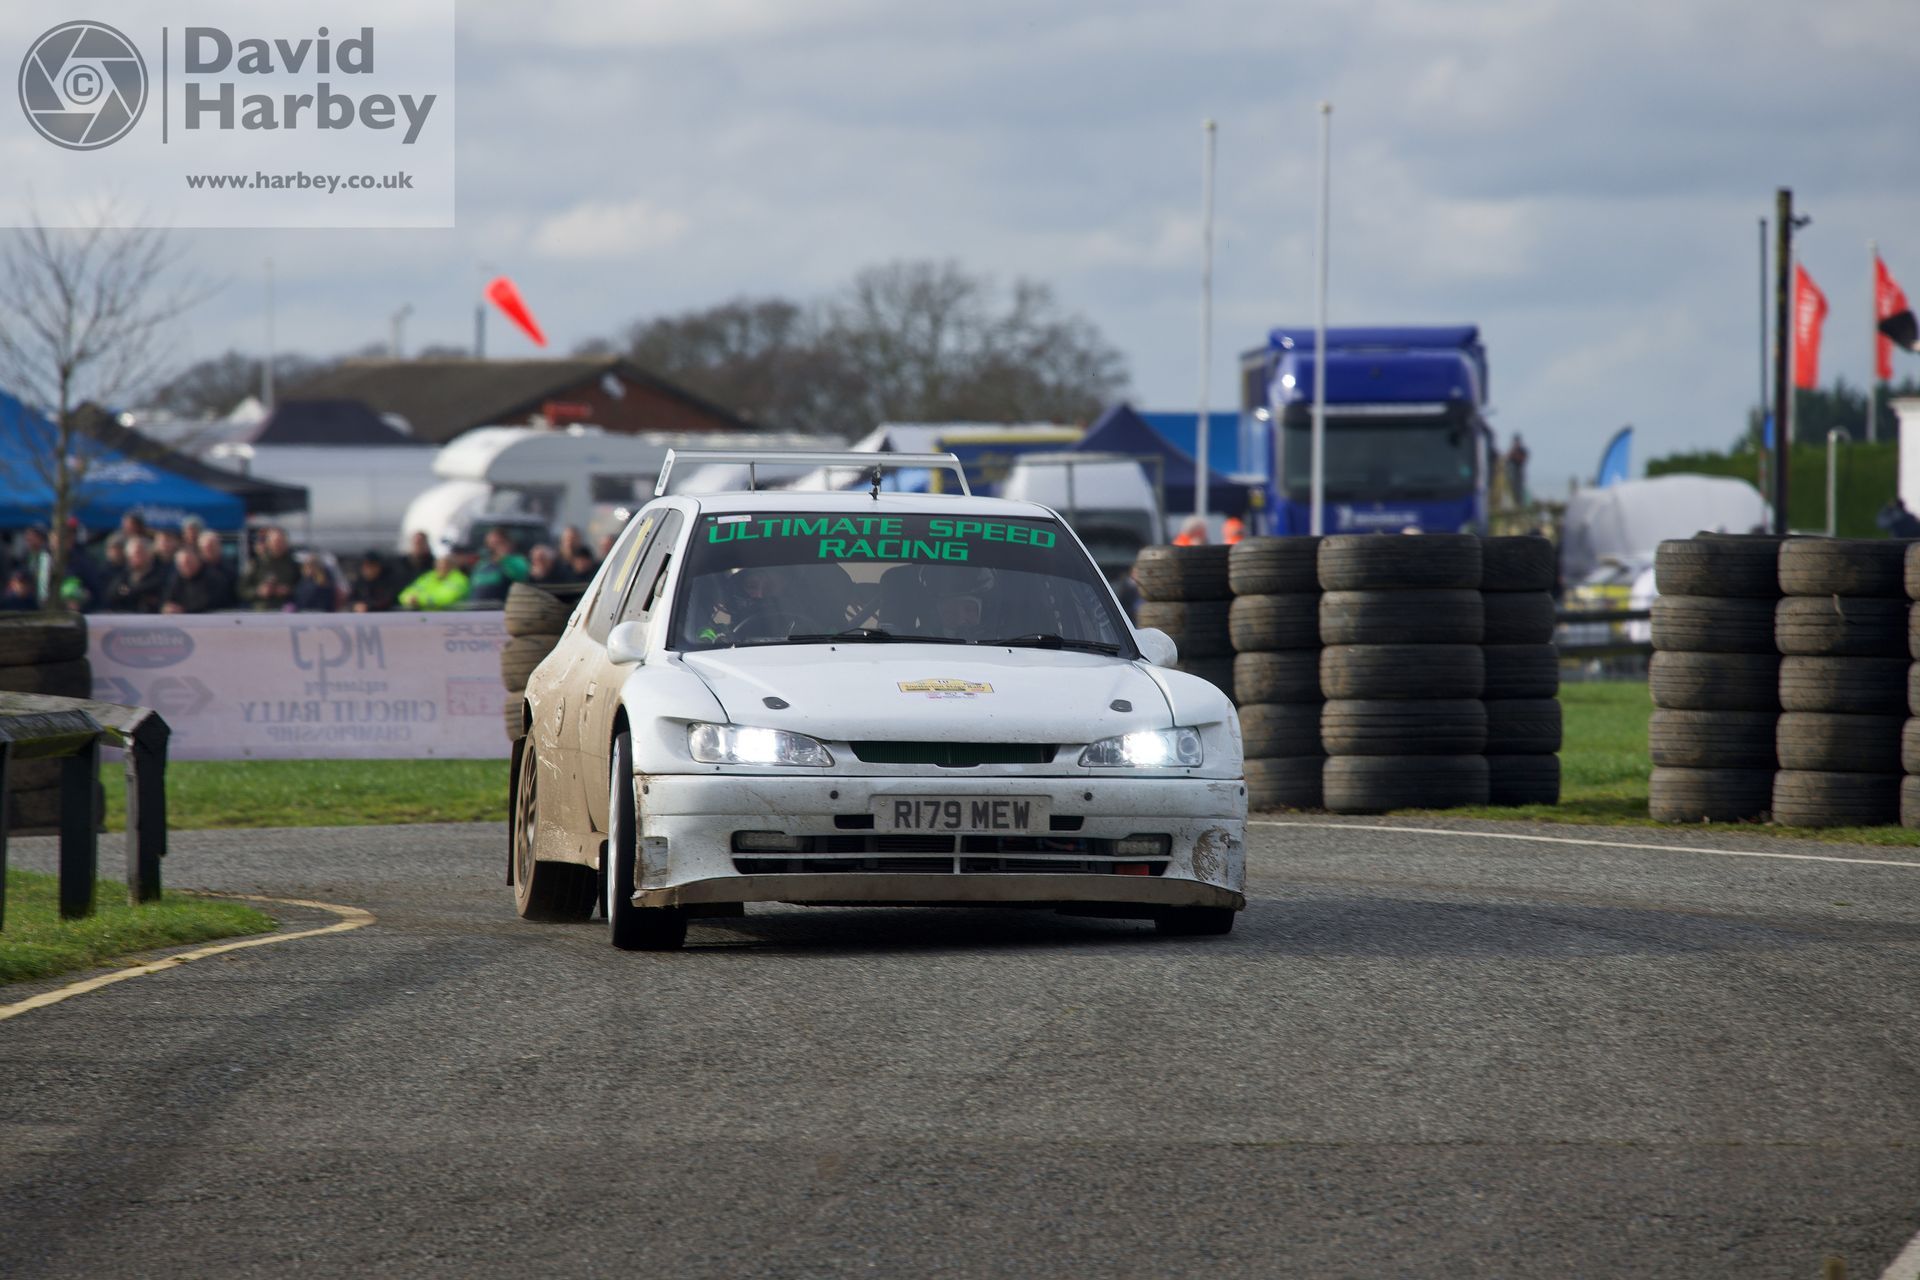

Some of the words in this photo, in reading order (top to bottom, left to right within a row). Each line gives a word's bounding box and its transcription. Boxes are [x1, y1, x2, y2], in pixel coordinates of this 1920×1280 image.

[708, 517, 904, 544] ULTIMATE
[928, 518, 1056, 548] SPEED
[818, 538, 968, 561] RACING
[894, 800, 962, 829] R179
[970, 800, 1031, 829] MEW
